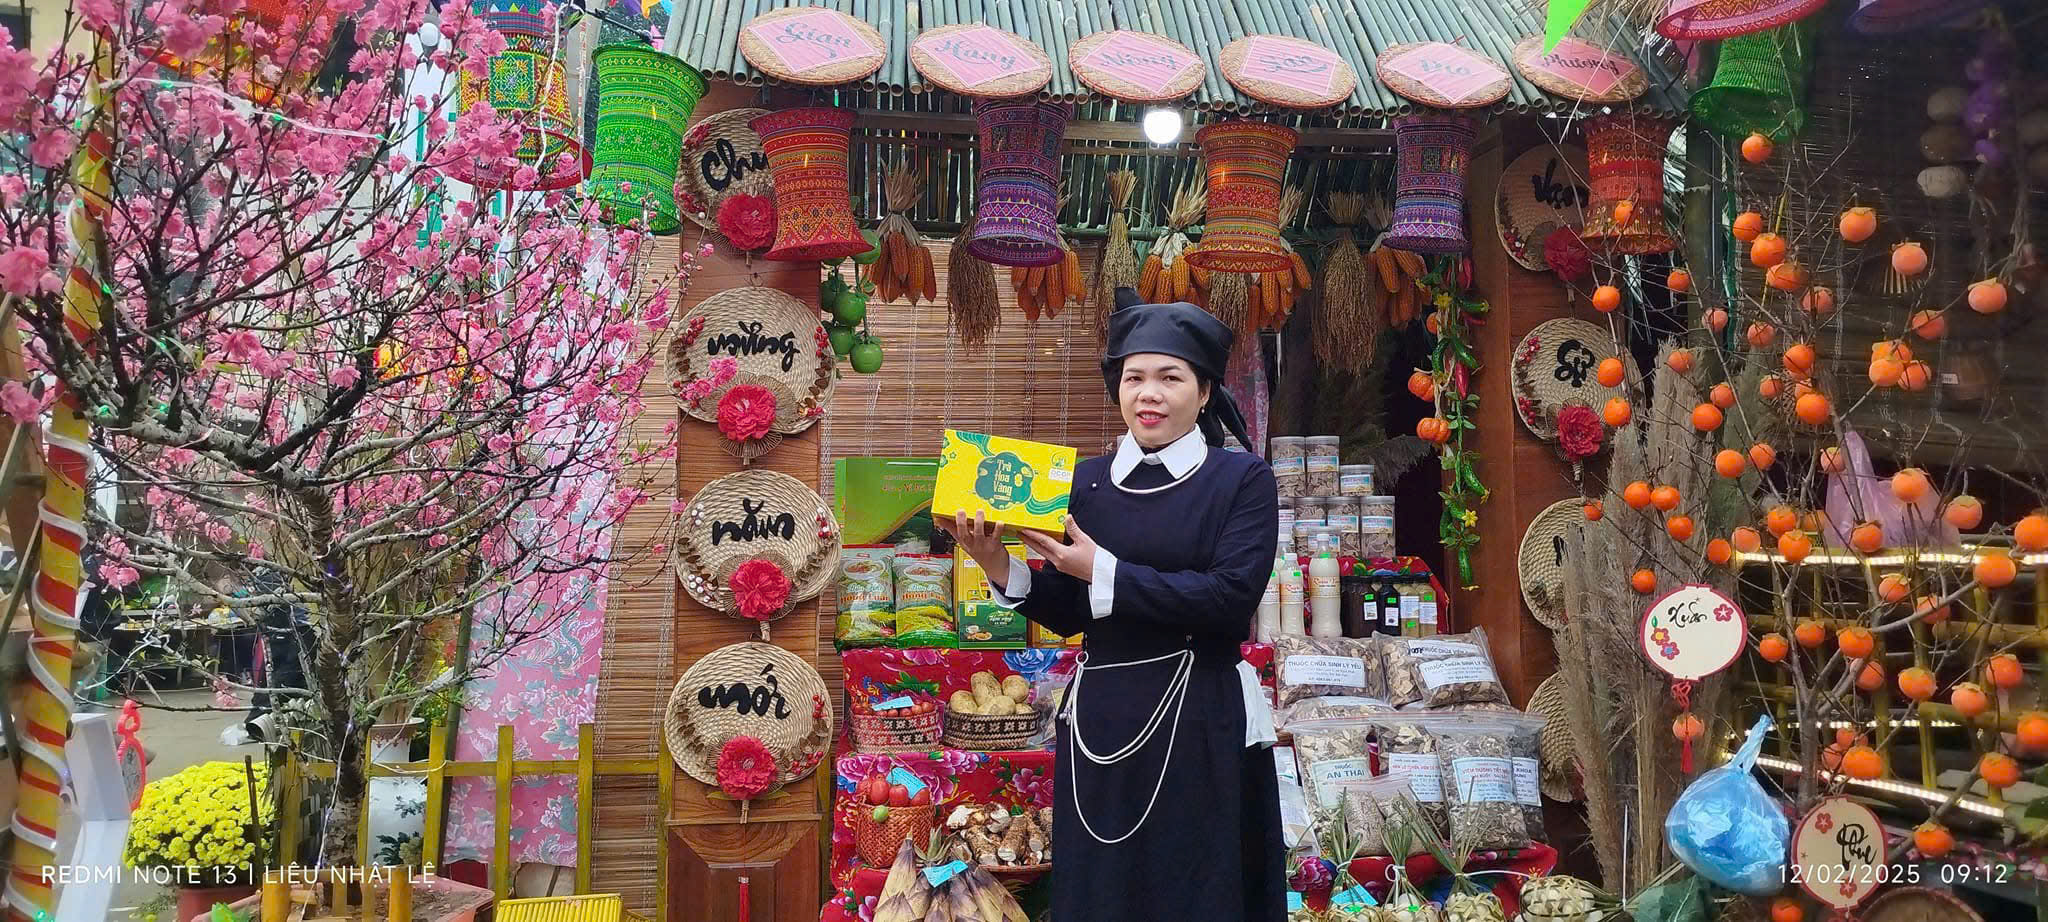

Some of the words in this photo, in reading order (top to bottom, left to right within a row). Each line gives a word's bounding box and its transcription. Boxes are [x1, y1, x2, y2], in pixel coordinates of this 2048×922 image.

[776, 23, 851, 58] Gian
[711, 497, 796, 547] năm
[698, 662, 792, 721] mới
